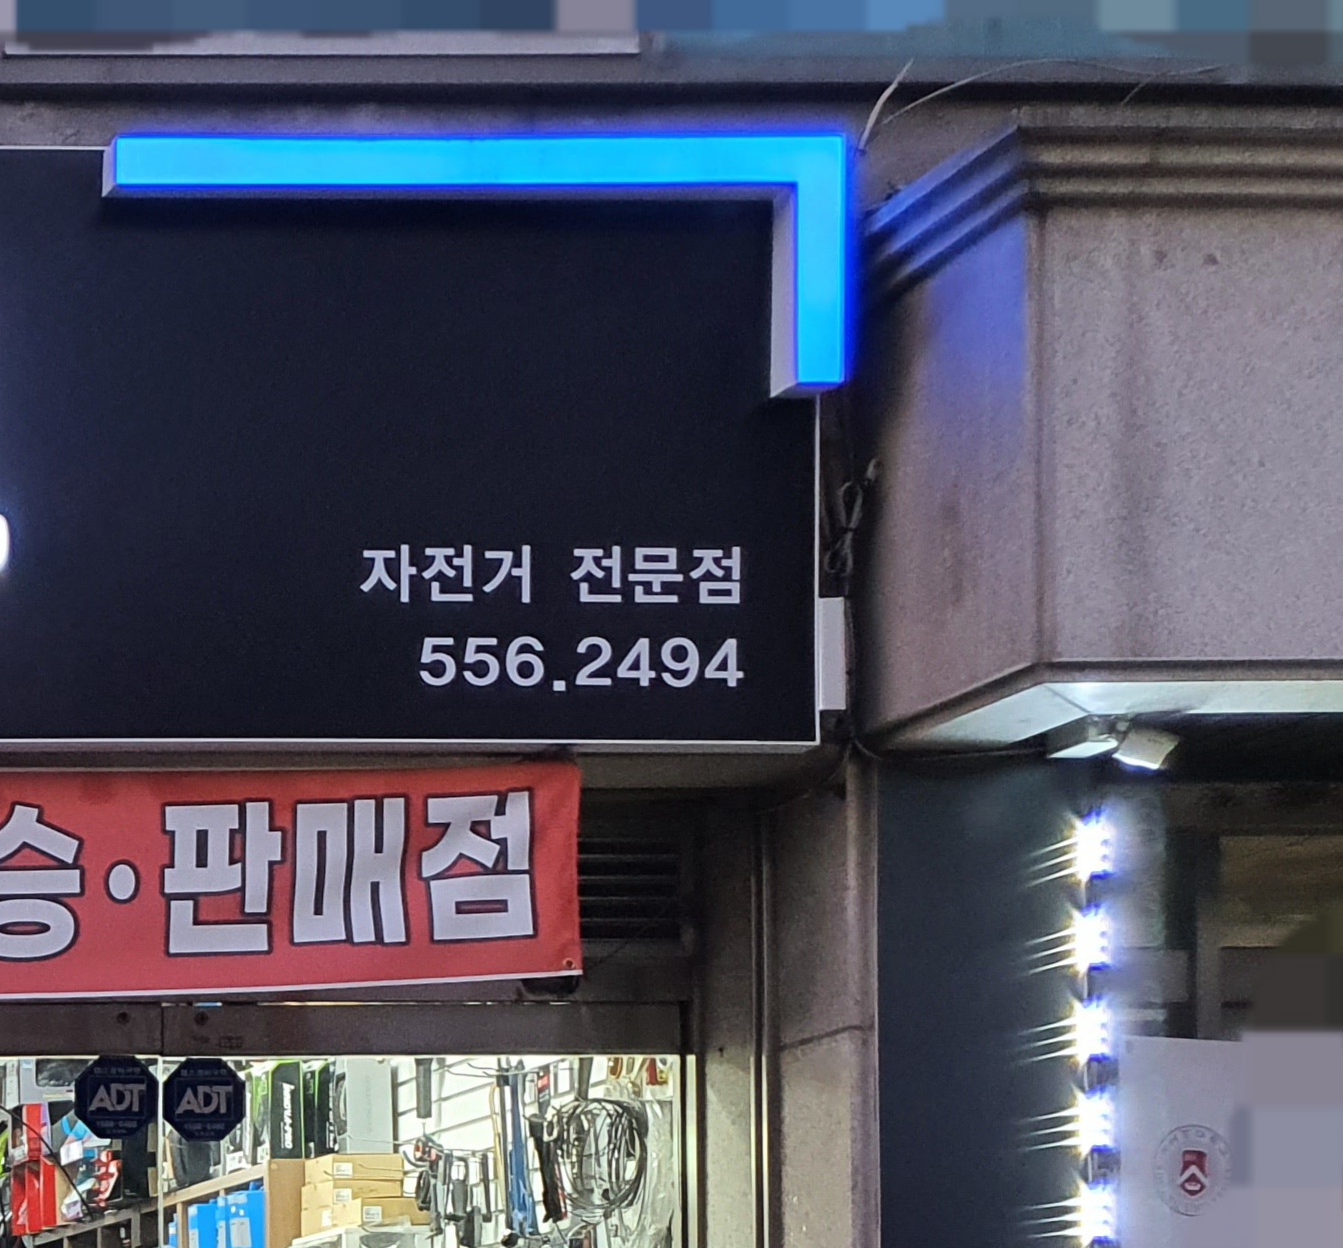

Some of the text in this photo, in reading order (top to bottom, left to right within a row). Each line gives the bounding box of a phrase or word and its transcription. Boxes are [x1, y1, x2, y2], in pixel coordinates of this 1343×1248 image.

[359, 544, 742, 604] 자전거 전문점
[418, 636, 744, 692] 556.2494
[89, 1083, 147, 1113] ADT
[174, 1085, 234, 1115] ADT
